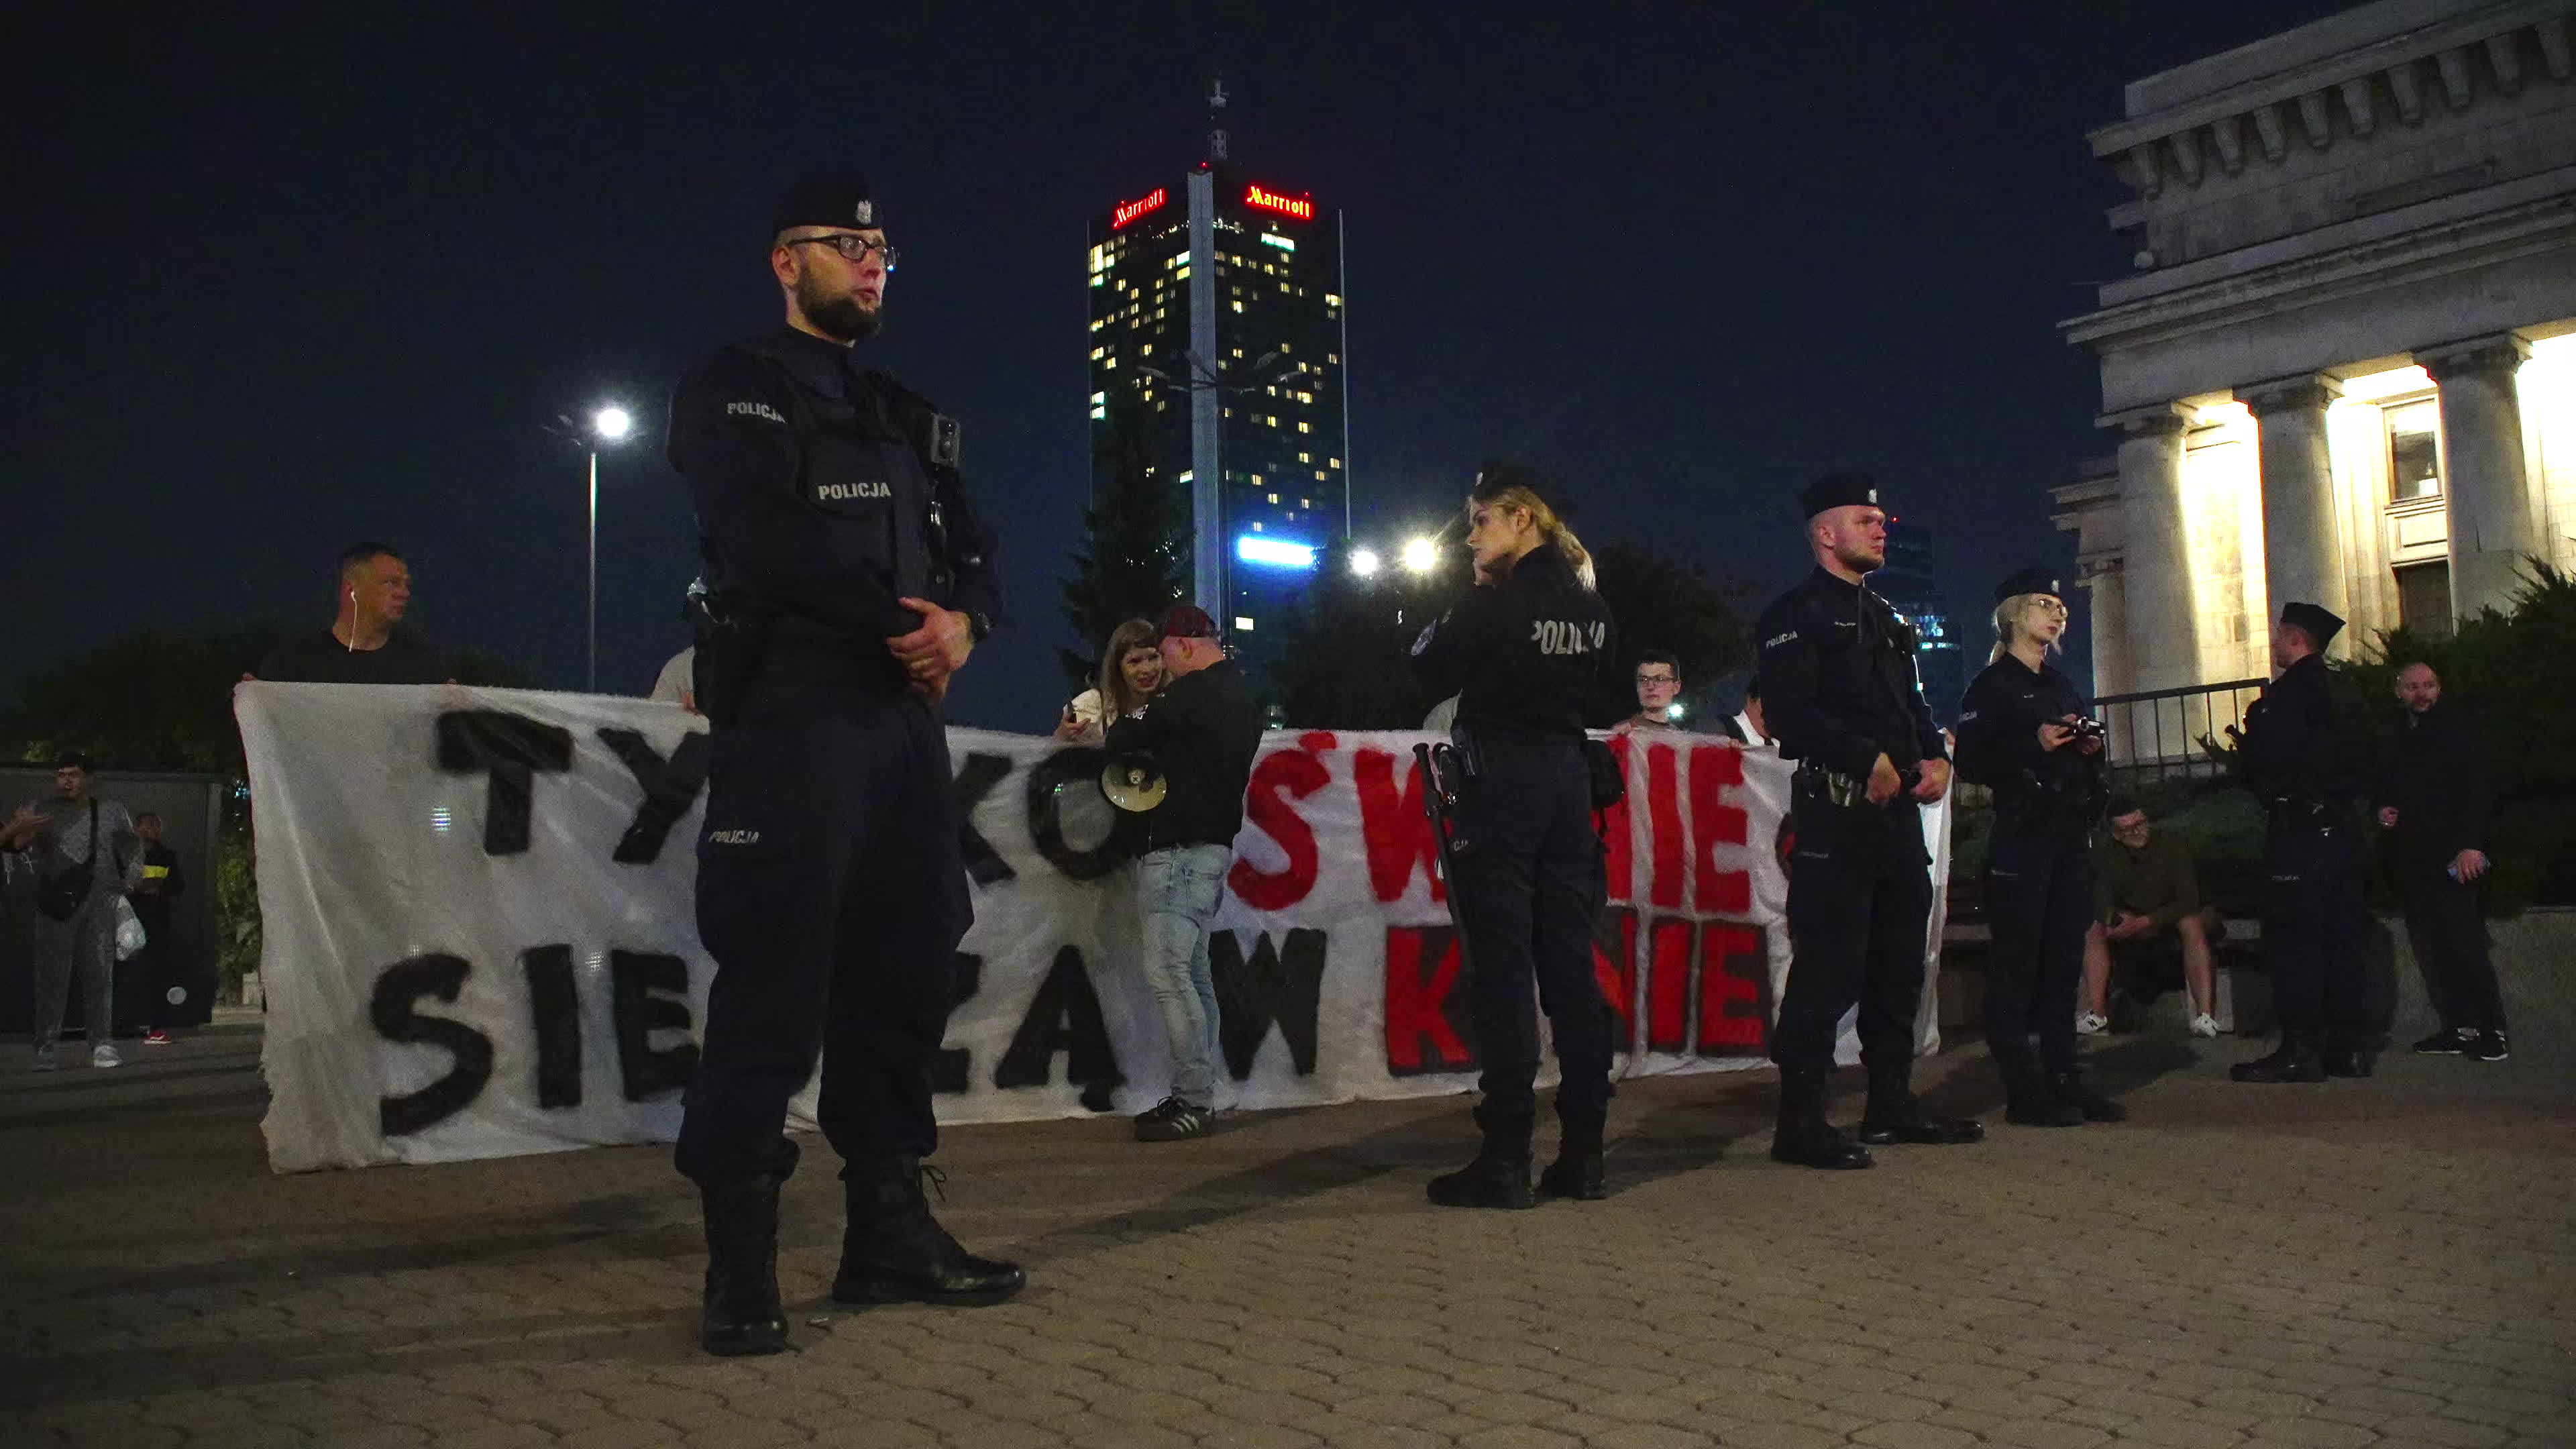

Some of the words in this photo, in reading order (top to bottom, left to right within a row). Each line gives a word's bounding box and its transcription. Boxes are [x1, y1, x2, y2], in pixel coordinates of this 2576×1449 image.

[1112, 187, 1165, 228] Marriott
[1246, 185, 1311, 218] Marriott
[727, 401, 788, 424] POLICJA
[818, 481, 892, 500] POLICJA
[1765, 630, 1799, 649] POLICJA
[436, 708, 1134, 881] TYKO
[708, 829, 762, 845] POLICJA
[370, 944, 1127, 1136] SIEĄ
[1209, 927, 1328, 1081] W
